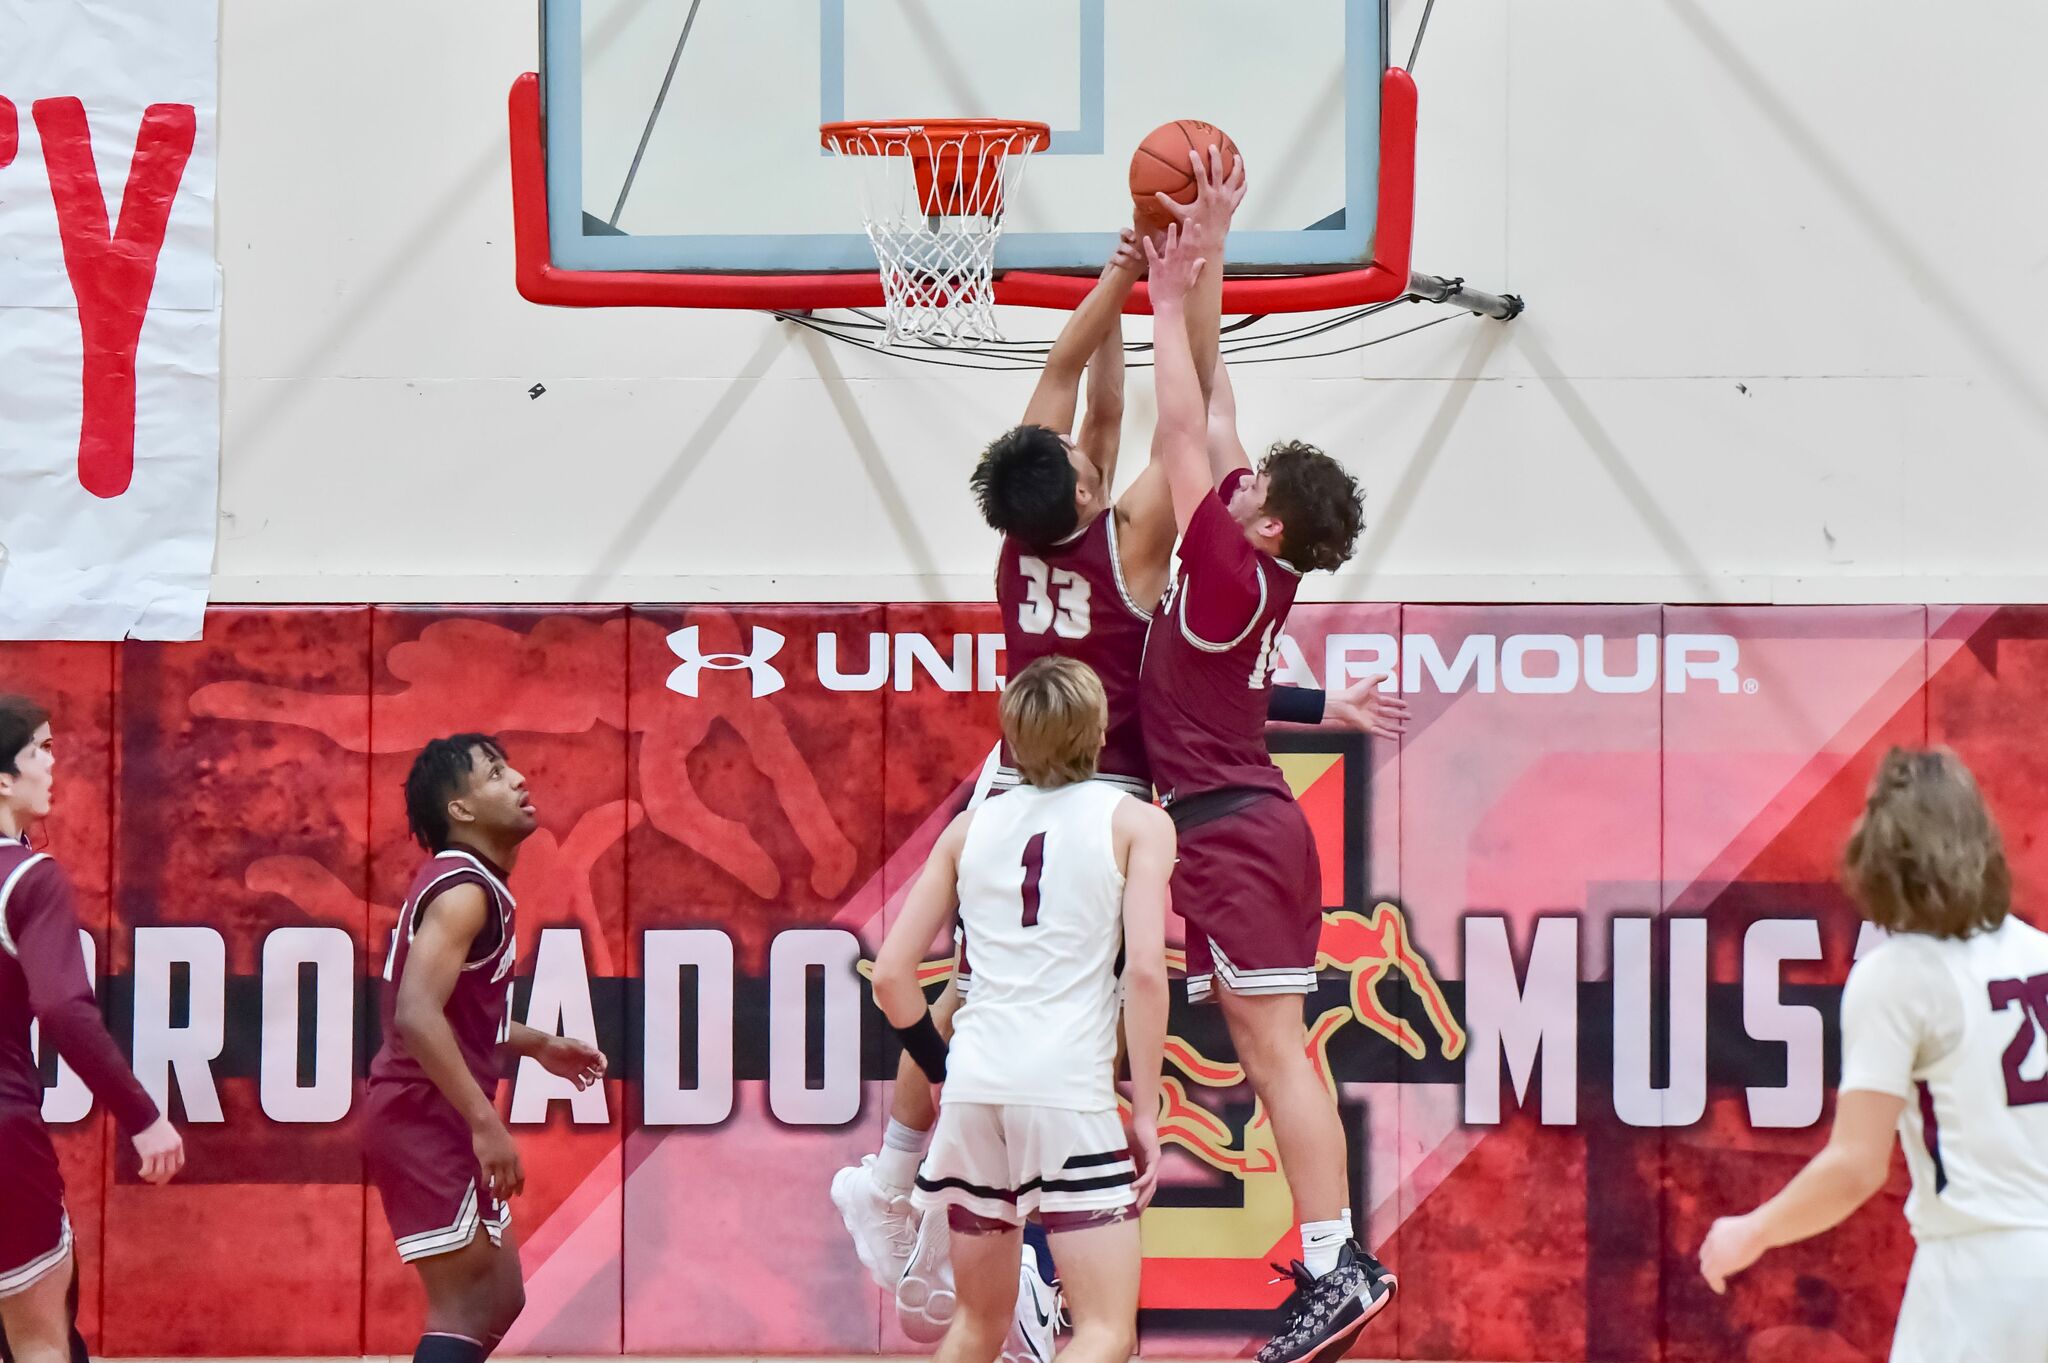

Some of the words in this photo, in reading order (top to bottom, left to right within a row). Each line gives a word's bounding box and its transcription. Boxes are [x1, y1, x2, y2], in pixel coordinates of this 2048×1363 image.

[0, 95, 196, 499] Y
[1019, 555, 1091, 640] 33
[1020, 832, 1047, 927] 1
[30, 926, 861, 1126] ROADO
[1465, 917, 1888, 1128] MUS
